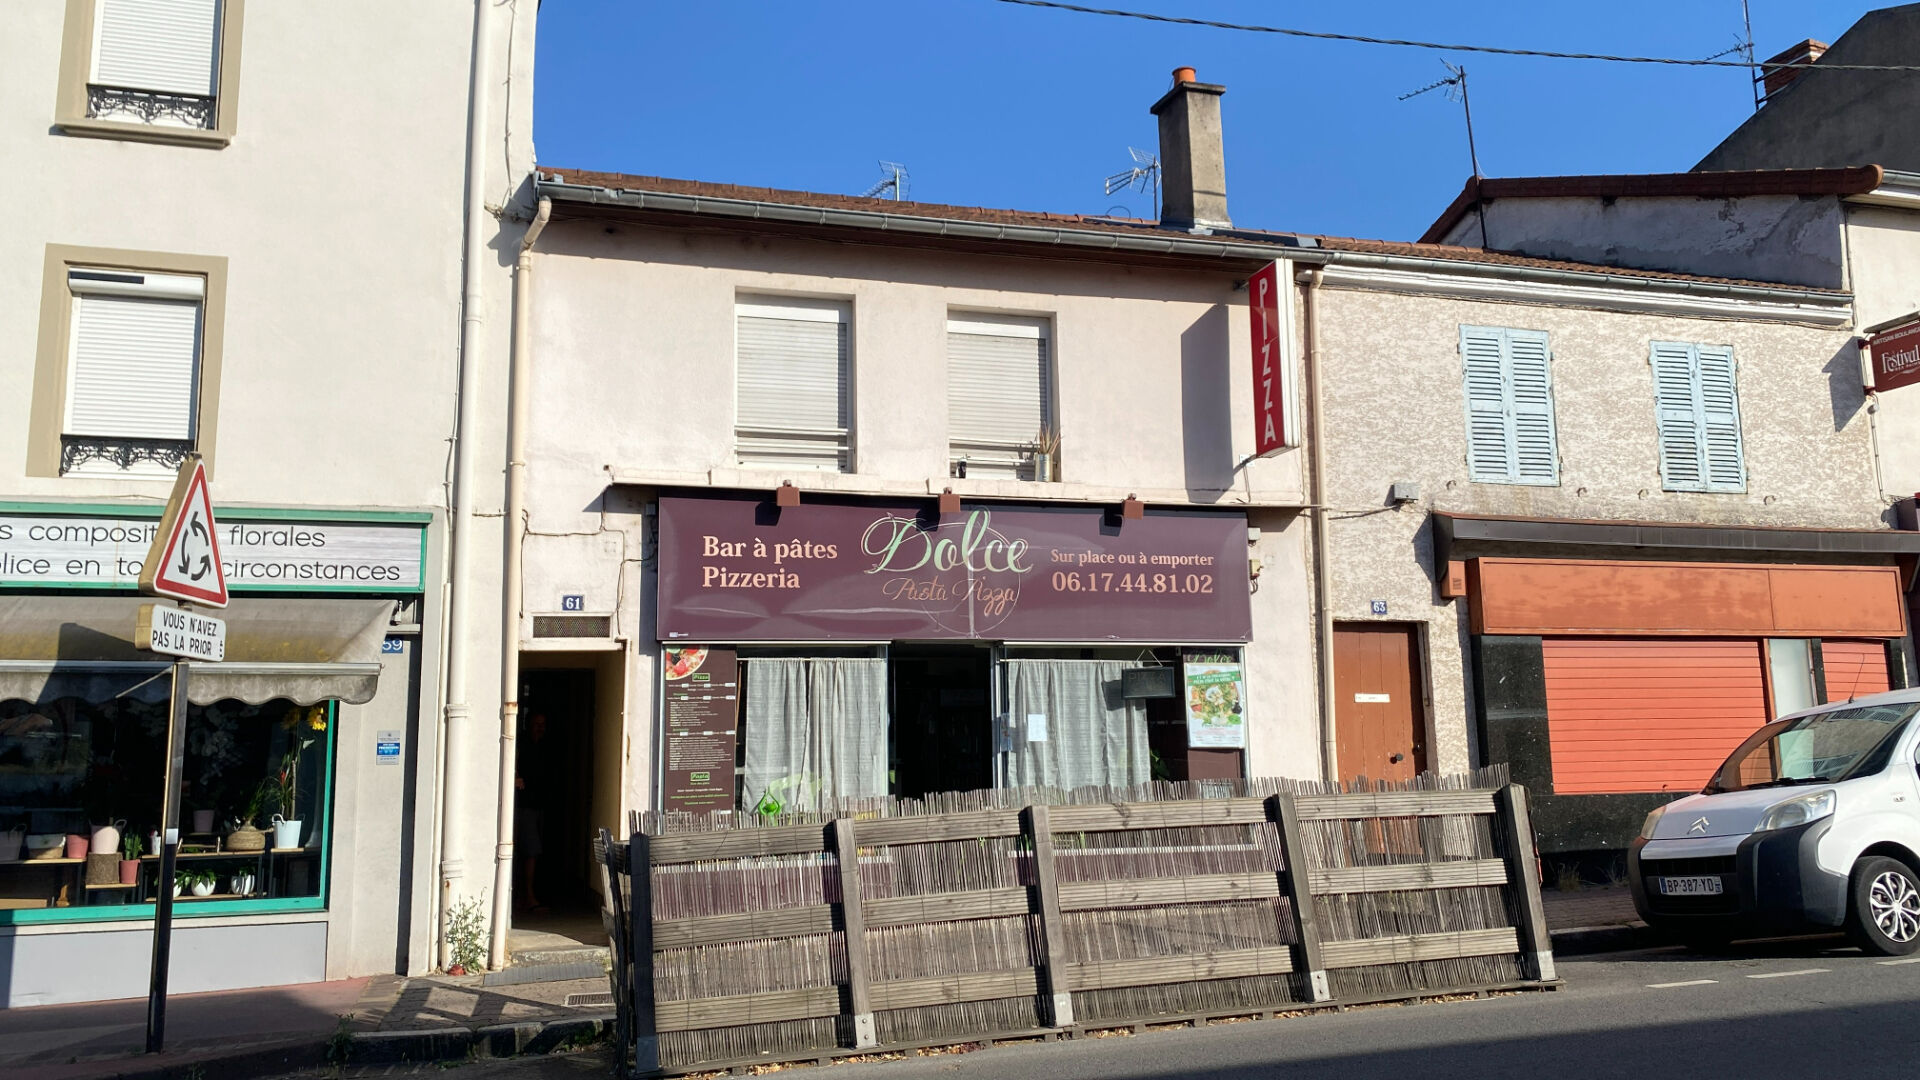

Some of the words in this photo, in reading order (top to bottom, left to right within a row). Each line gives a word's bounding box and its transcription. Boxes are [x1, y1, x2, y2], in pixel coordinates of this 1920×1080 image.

[1259, 277, 1277, 446] PIZZA
[29, 524, 158, 547] composit
[229, 524, 326, 547] florales
[861, 505, 1034, 574] Dolce
[702, 535, 747, 557] Bar
[753, 537, 767, 558] à
[774, 538, 838, 564] pâtes
[1051, 549, 1075, 563] Sur
[1079, 550, 1115, 567] place
[1118, 554, 1136, 564] ou
[1139, 552, 1147, 564] à
[1151, 552, 1214, 569] emporter
[66, 559, 100, 575] en
[222, 560, 400, 581] circonstances
[702, 566, 800, 588] Pizzeria
[1052, 571, 1213, 594] 06.17.44.81.02
[565, 597, 581, 610] 61
[1373, 601, 1386, 612] 63
[163, 611, 185, 630] VOUS
[189, 617, 217, 637] N'AVEZ
[152, 630, 170, 648] PAS
[174, 634, 185, 651] LA
[189, 637, 212, 656] PRIOR
[1666, 878, 1714, 892] BP-387-YD
